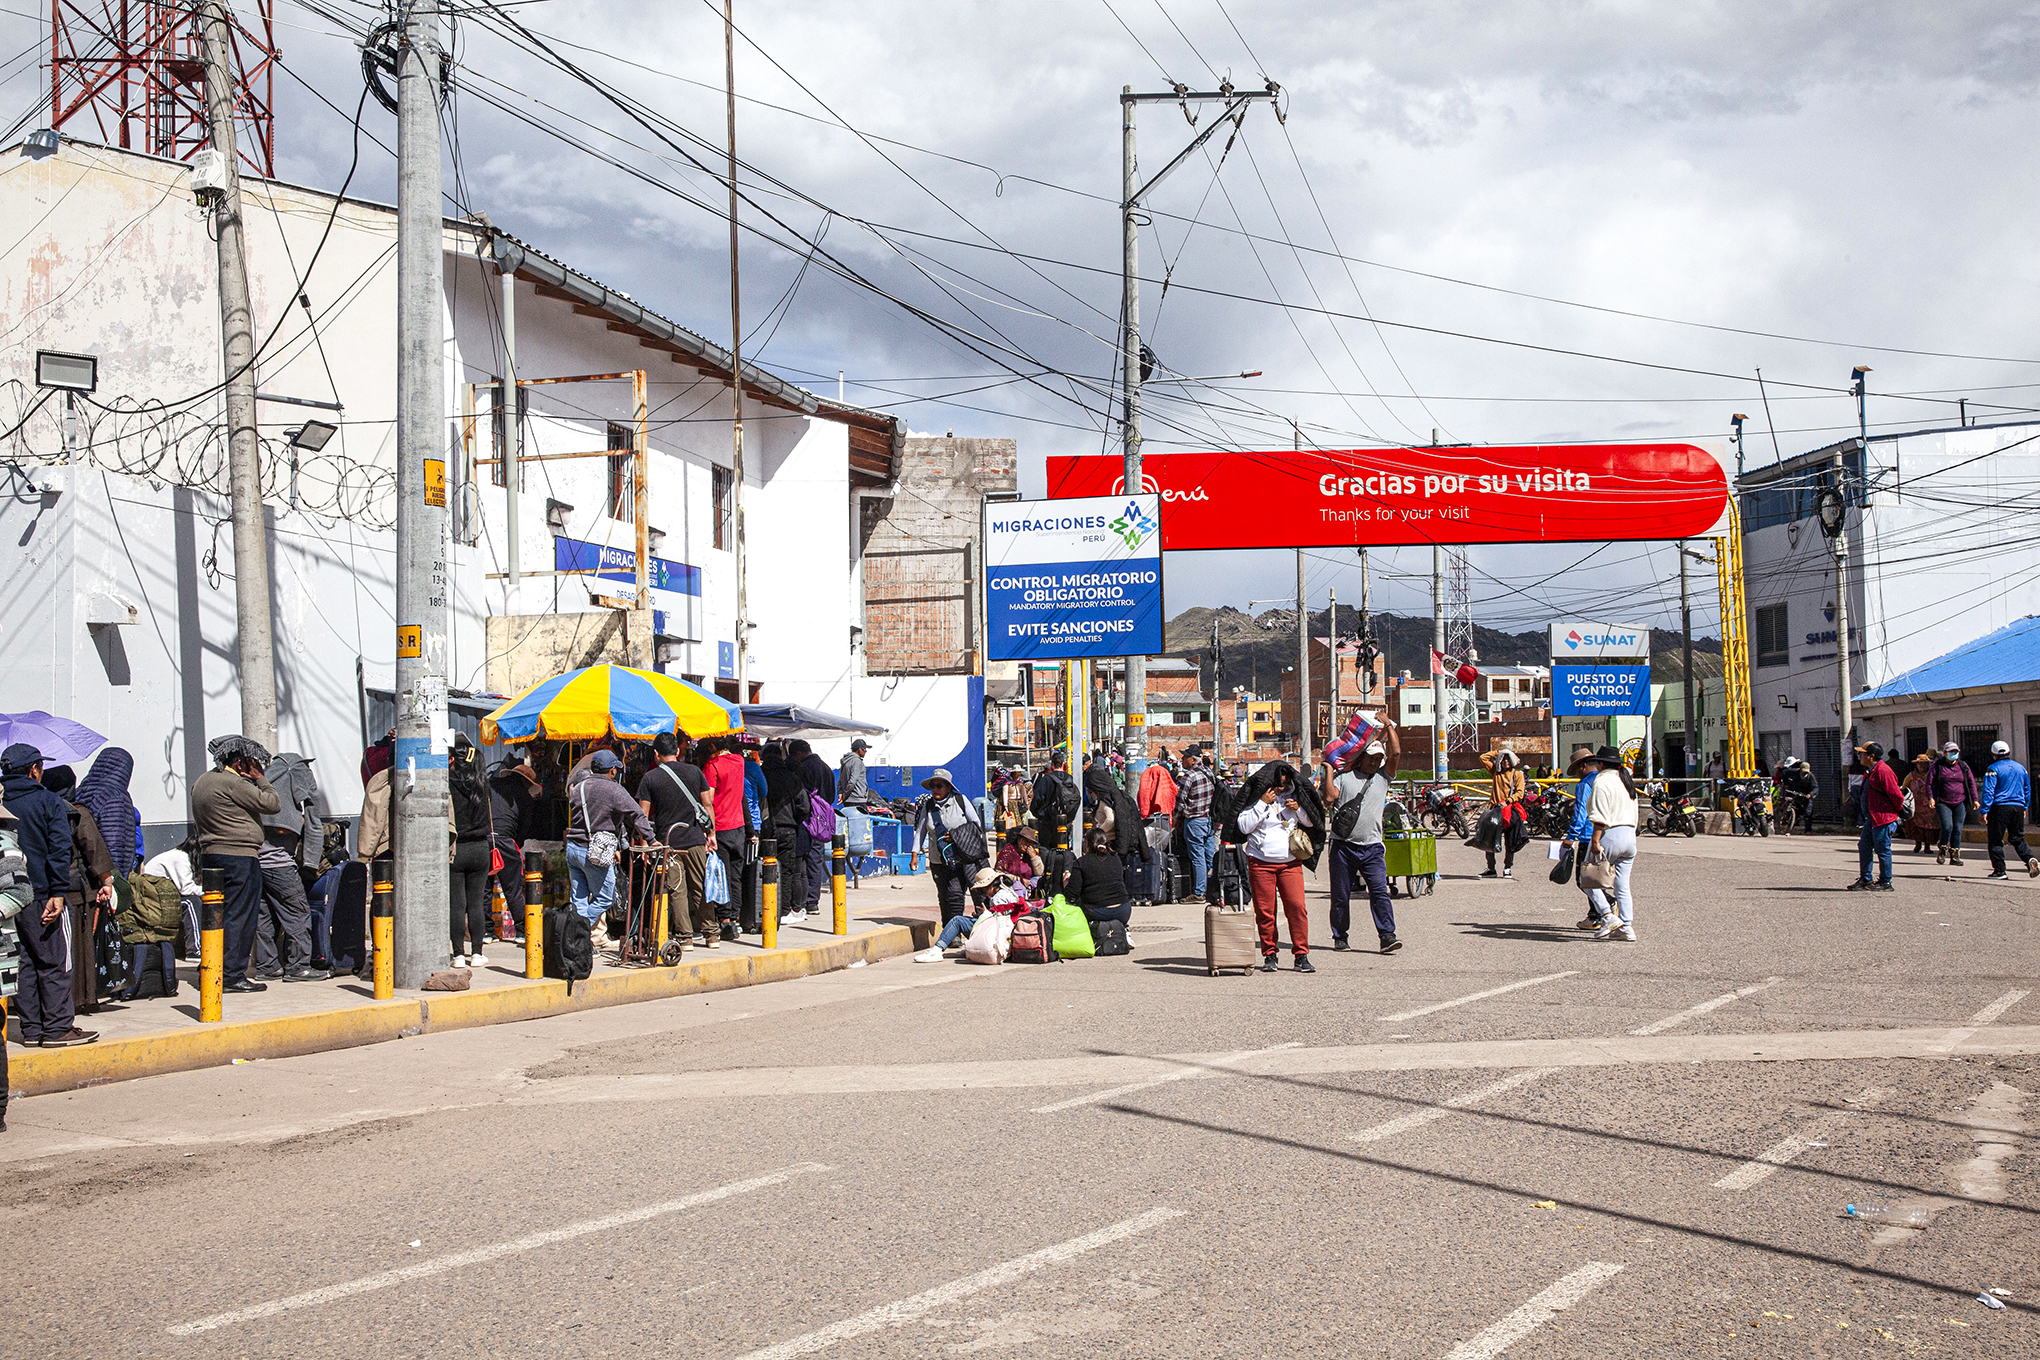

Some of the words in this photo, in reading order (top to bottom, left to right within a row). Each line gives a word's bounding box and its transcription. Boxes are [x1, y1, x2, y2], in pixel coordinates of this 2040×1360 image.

[1319, 470, 1416, 497] Gracias
[1424, 474, 1466, 498] por
[1478, 474, 1508, 494] su
[1515, 468, 1591, 492] visita
[1319, 507, 1371, 522] Thanks
[1375, 506, 1395, 521] for
[1400, 507, 1434, 523] your
[1438, 505, 1470, 520] visit
[992, 516, 1106, 533] MIGRACIONES
[1082, 534, 1106, 543] PERÚ
[599, 547, 658, 574] MIGRACIES
[990, 575, 1060, 590] CONTROL
[1062, 571, 1157, 588] MIGRATORIO
[1023, 586, 1124, 602] OBLIGATORIO
[1009, 602, 1055, 611] MANDATORY
[1056, 600, 1099, 610] MIGRATORY
[1100, 599, 1136, 608] CONTROL
[1008, 622, 1049, 636] EVITE
[1050, 619, 1135, 635] SANCIONES
[1039, 636, 1063, 645] AVOID
[1064, 634, 1103, 644] PENALTIES
[1583, 635, 1637, 646] SUNAT
[1567, 674, 1616, 684] PUESTO
[1619, 674, 1636, 684] DE
[1571, 685, 1632, 695] CONTROL
[1574, 699, 1631, 708] Desaguadero
